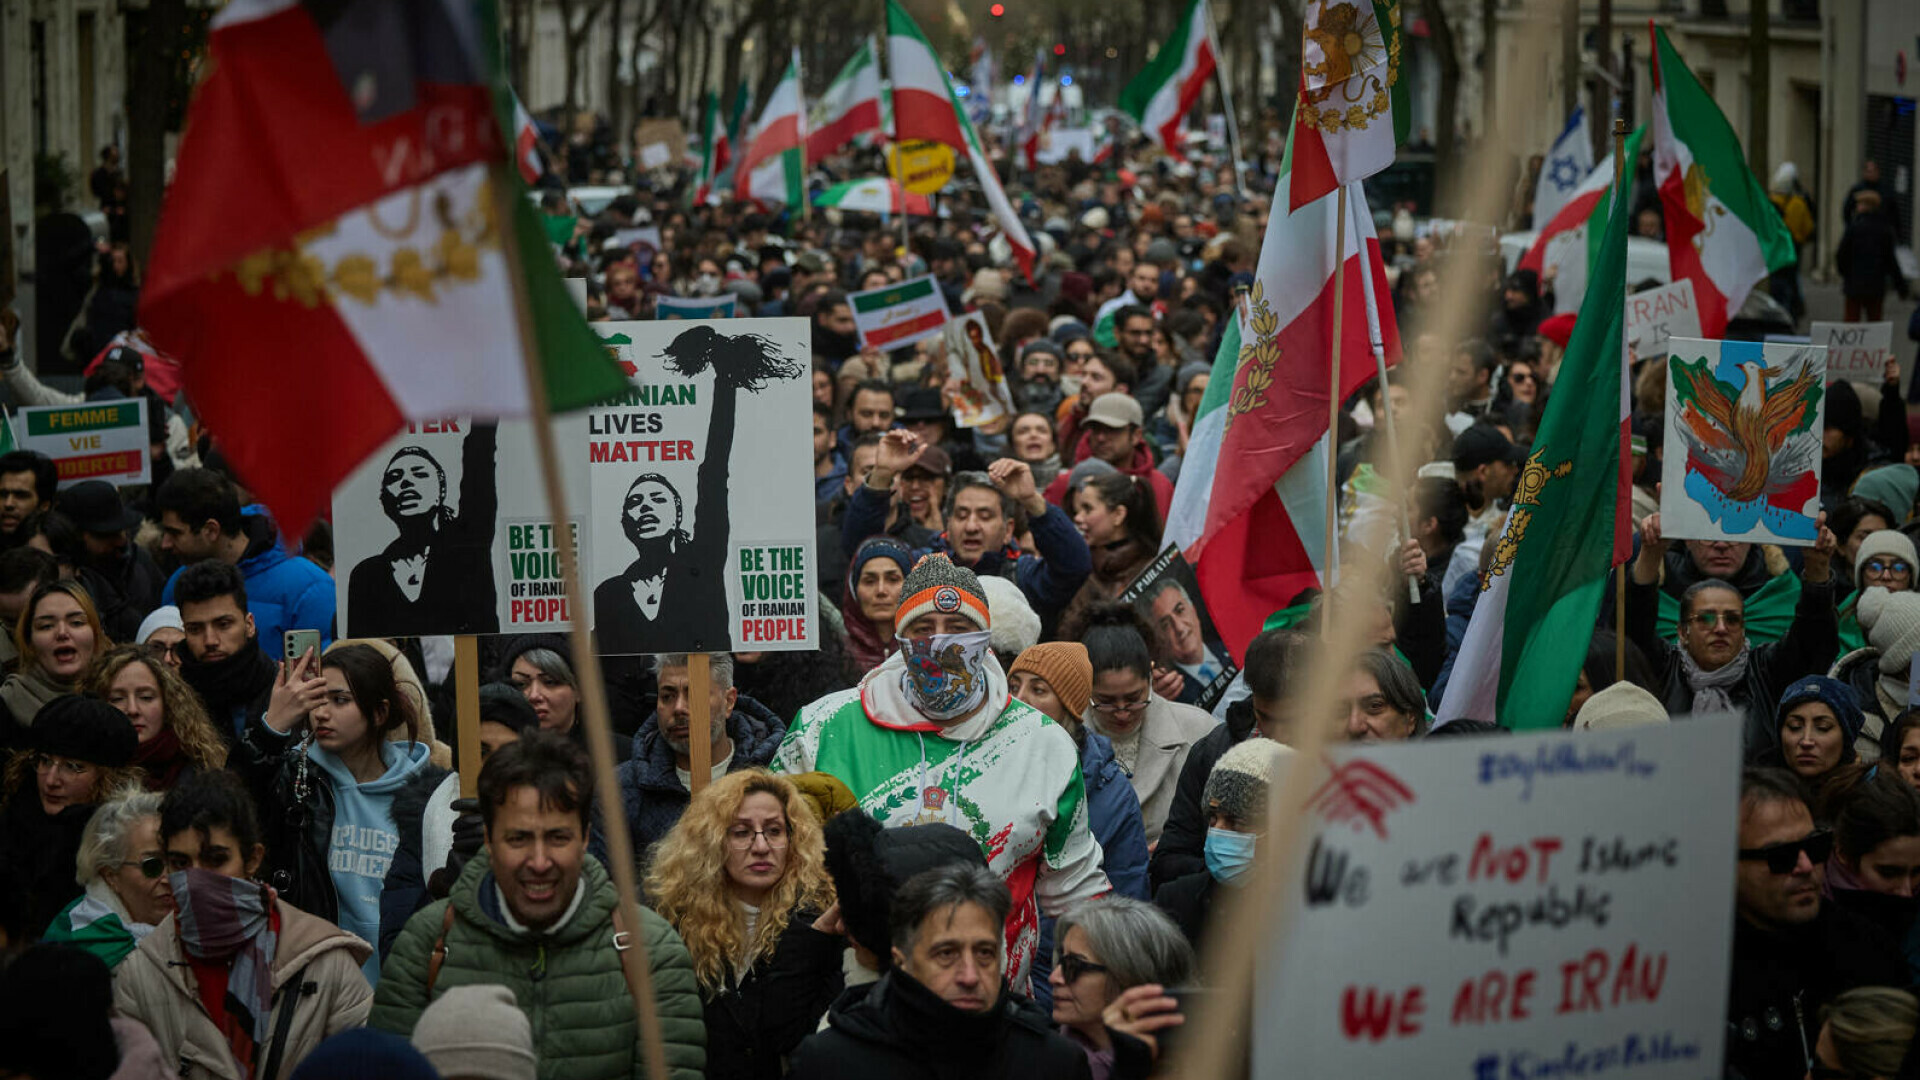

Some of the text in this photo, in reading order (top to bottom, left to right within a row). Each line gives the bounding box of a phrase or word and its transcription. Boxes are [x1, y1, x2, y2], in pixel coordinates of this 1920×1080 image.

[1652, 322, 1671, 345] IS
[1829, 327, 1868, 347] NOT
[1827, 348, 1887, 371] ILENT
[50, 407, 119, 428] FEMME
[589, 413, 663, 435] LIVES
[69, 435, 102, 452] VIE
[589, 440, 695, 463] MATTER
[58, 455, 127, 477] IBERTÉ
[509, 524, 535, 549] BE
[740, 547, 804, 571] BE THE
[511, 583, 525, 597] OF
[741, 573, 805, 601] VOICE
[511, 598, 570, 623] PEOPL
[742, 602, 805, 617] OF IRANIAN
[742, 618, 806, 642] PEOPLE
[1305, 836, 1370, 908] We
[1401, 852, 1460, 886] are
[1468, 832, 1563, 882] NOT
[1451, 884, 1612, 956] Republic
[1340, 941, 1668, 1044] WE ARE IRAN
